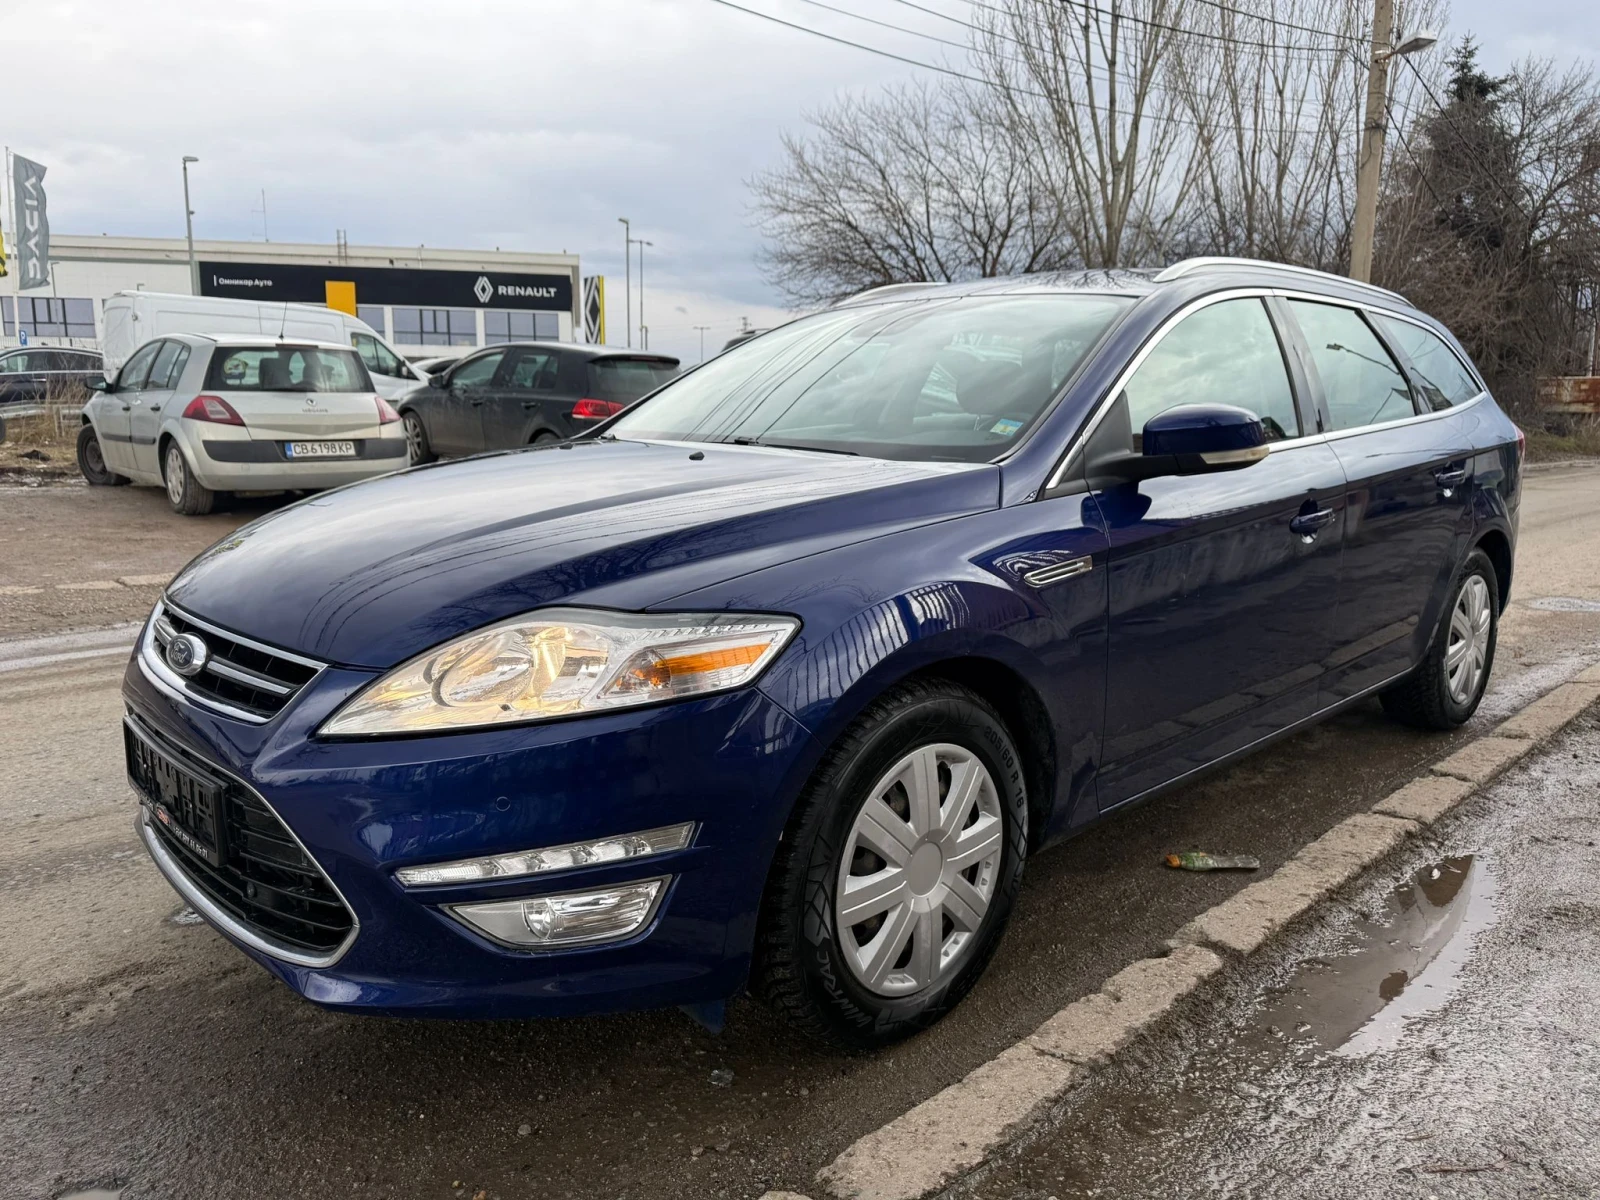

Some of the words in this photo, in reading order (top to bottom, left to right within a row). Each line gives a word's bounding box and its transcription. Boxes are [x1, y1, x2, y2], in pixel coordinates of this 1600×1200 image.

[24, 175, 41, 279] DACIA
[498, 285, 557, 298] RENAULT
[171, 641, 188, 664] Ford
[983, 725, 1015, 769] 205/60
[1010, 769, 1019, 783] R
[1015, 787, 1025, 809] 16
[816, 951, 873, 1029] WINTRAC
